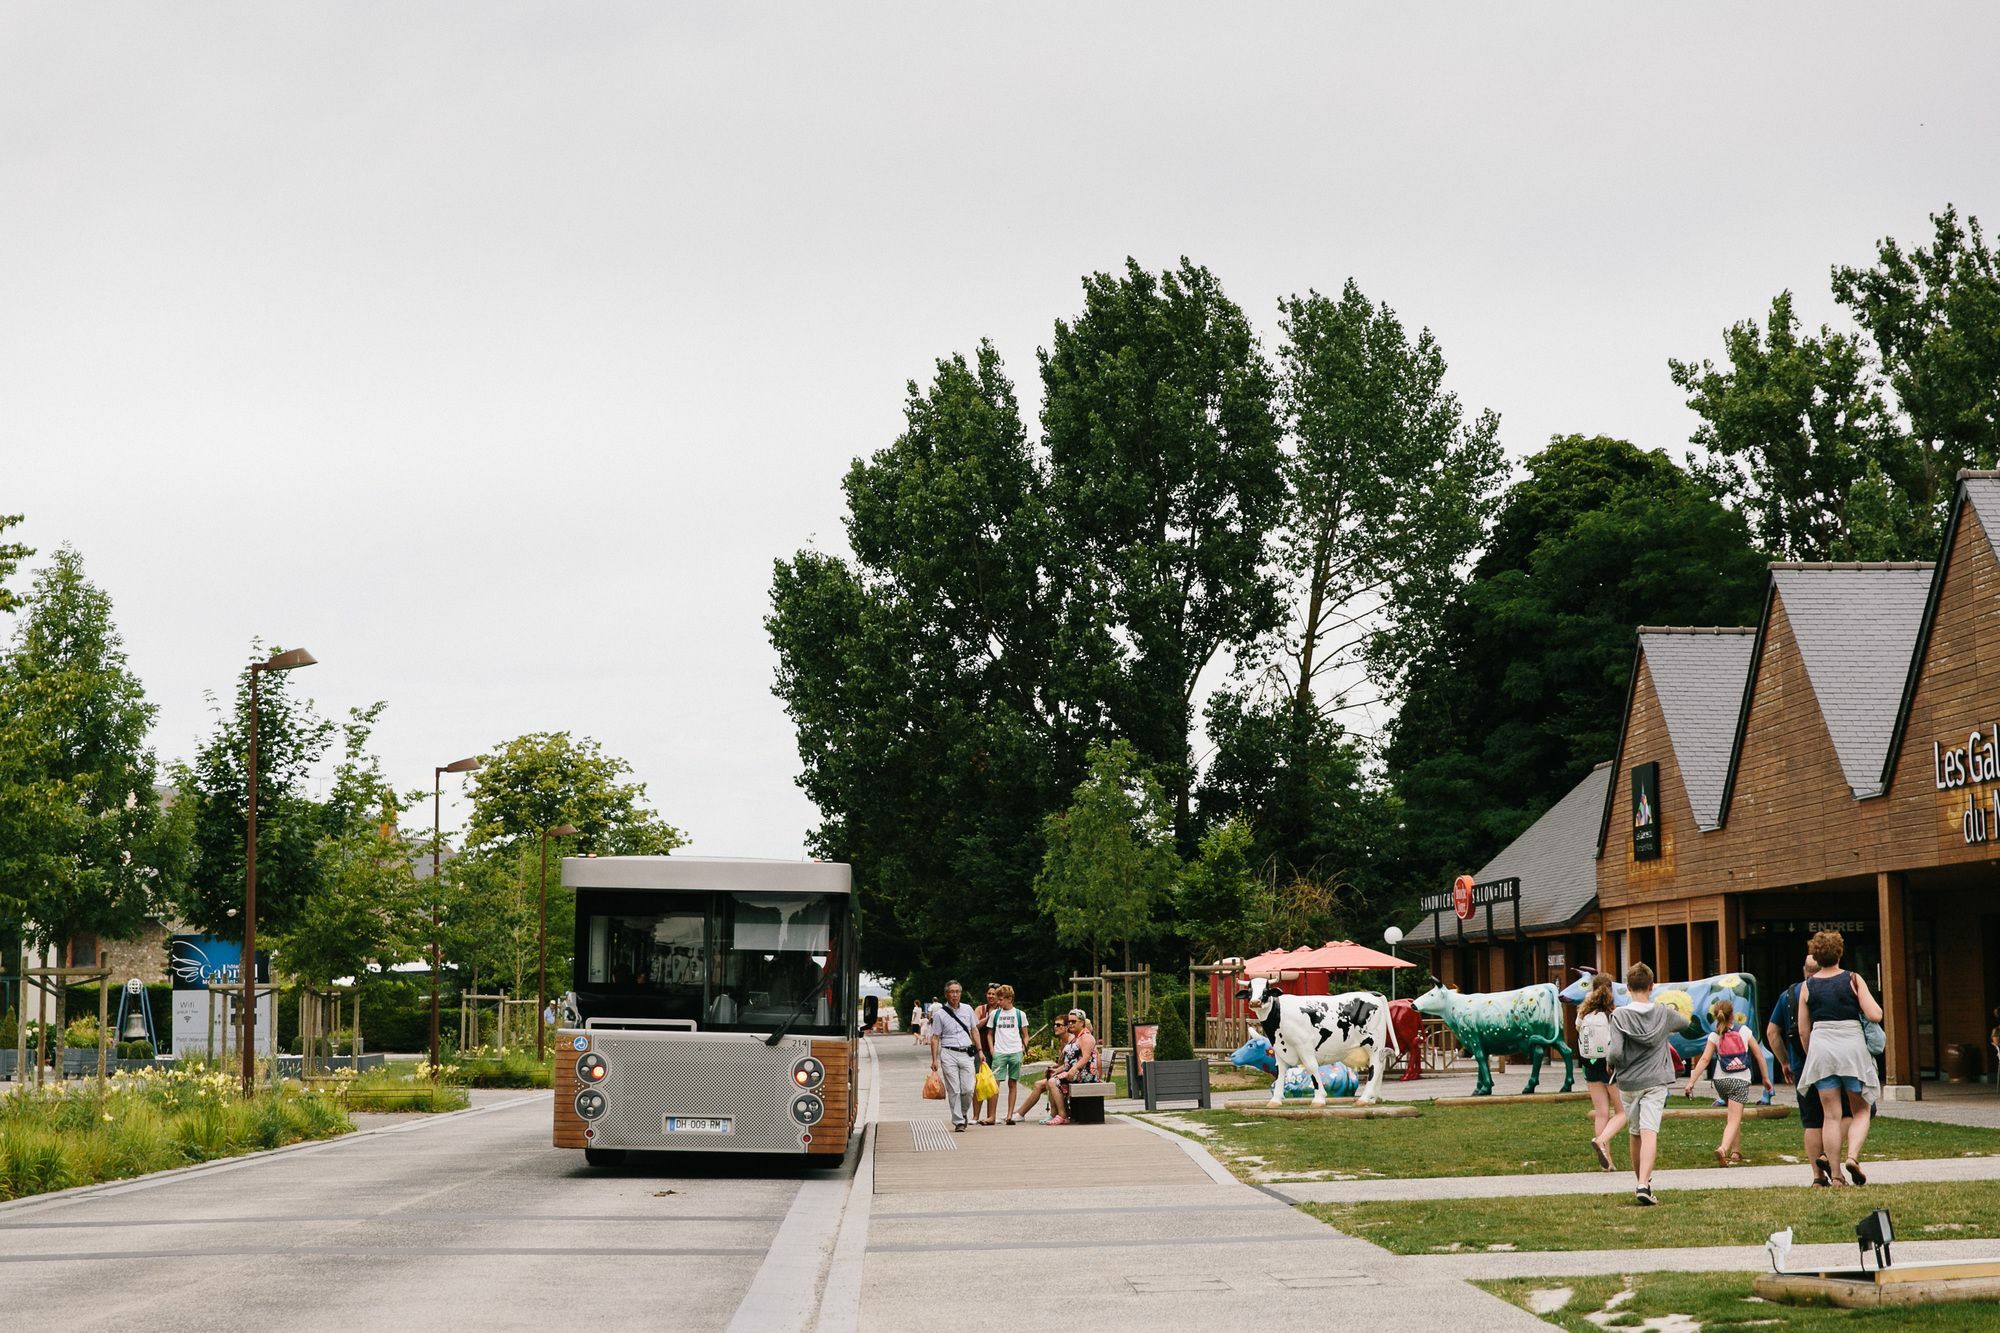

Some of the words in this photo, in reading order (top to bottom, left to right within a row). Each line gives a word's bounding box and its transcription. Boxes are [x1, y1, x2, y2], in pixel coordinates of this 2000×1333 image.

[1934, 741, 1965, 790] Les
[1963, 793, 1986, 844] du
[1472, 886, 1494, 904] SALON
[1499, 881, 1512, 899] THE
[1808, 921, 1864, 933] ENTREE
[179, 1000, 195, 1009] Wifi
[792, 1039, 807, 1048] 214
